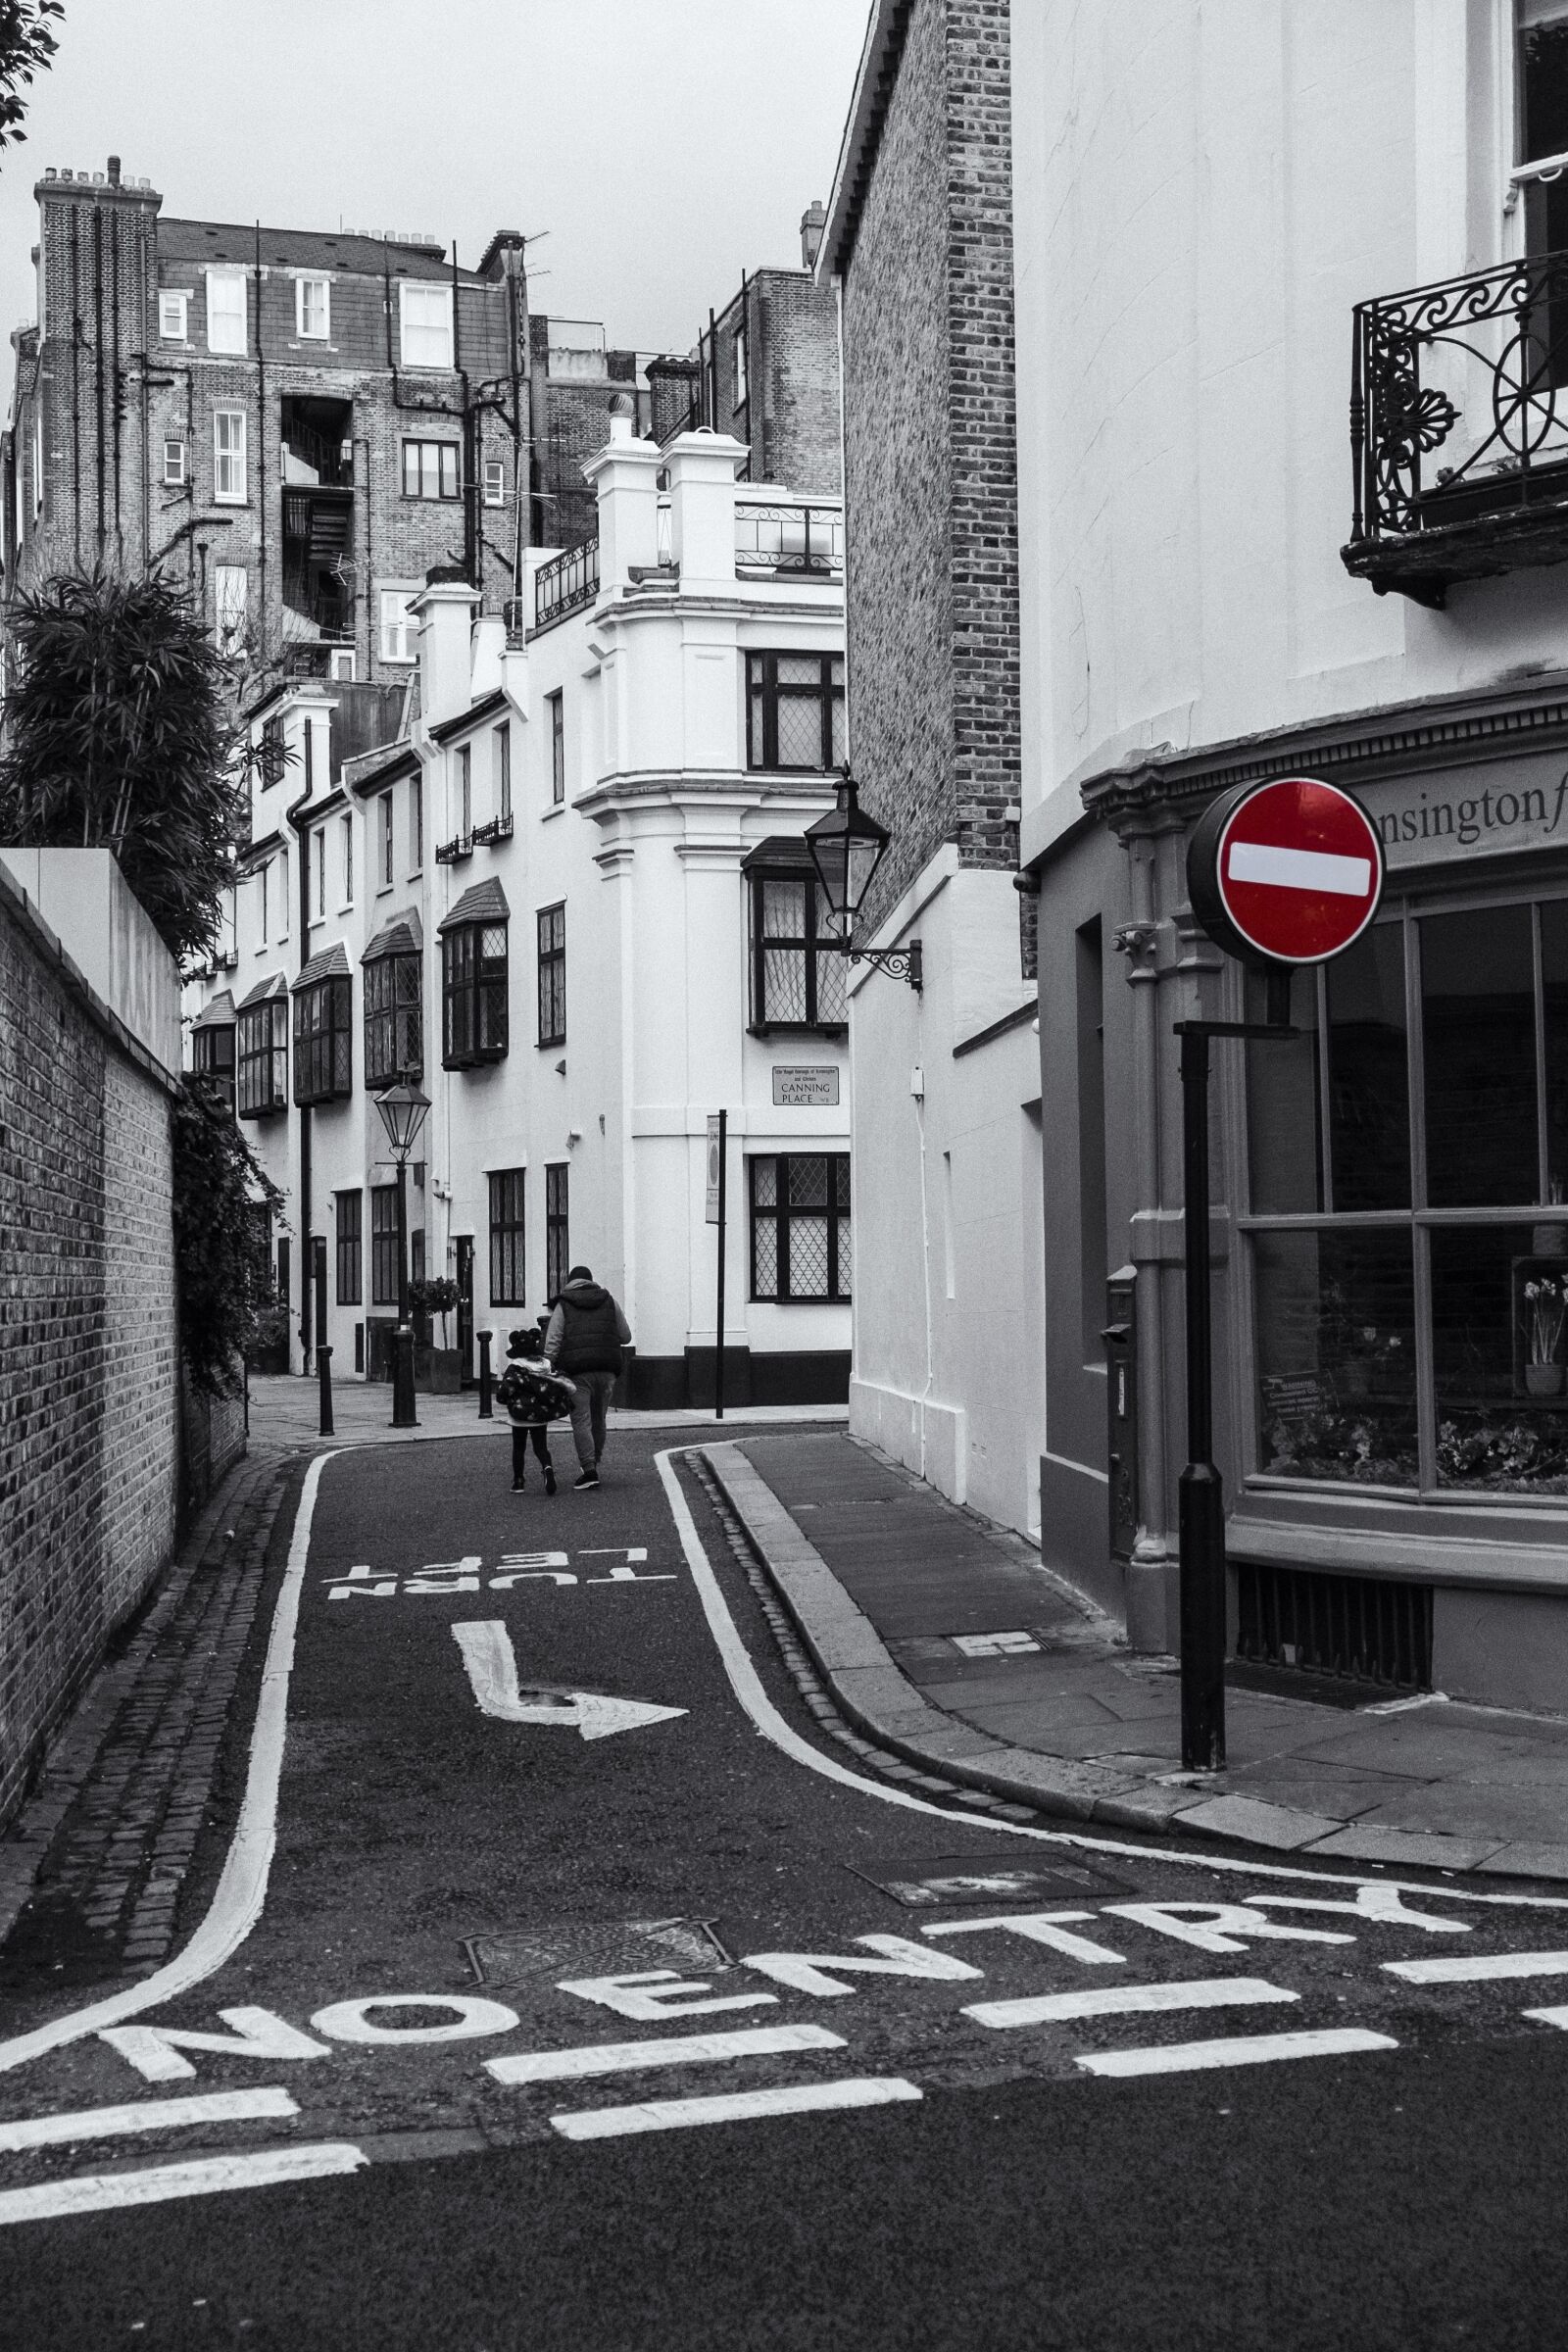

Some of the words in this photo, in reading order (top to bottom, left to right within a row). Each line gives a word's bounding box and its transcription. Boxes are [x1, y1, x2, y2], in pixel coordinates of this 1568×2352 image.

[1379, 788, 1548, 845] nsington
[781, 1084, 830, 1093] CANNING
[782, 1094, 813, 1103] PLACE
[319, 1547, 648, 1583] LEFT
[327, 1567, 677, 1599] TURN
[99, 1994, 520, 2082] NO
[557, 1886, 1473, 2021] ENTRY
